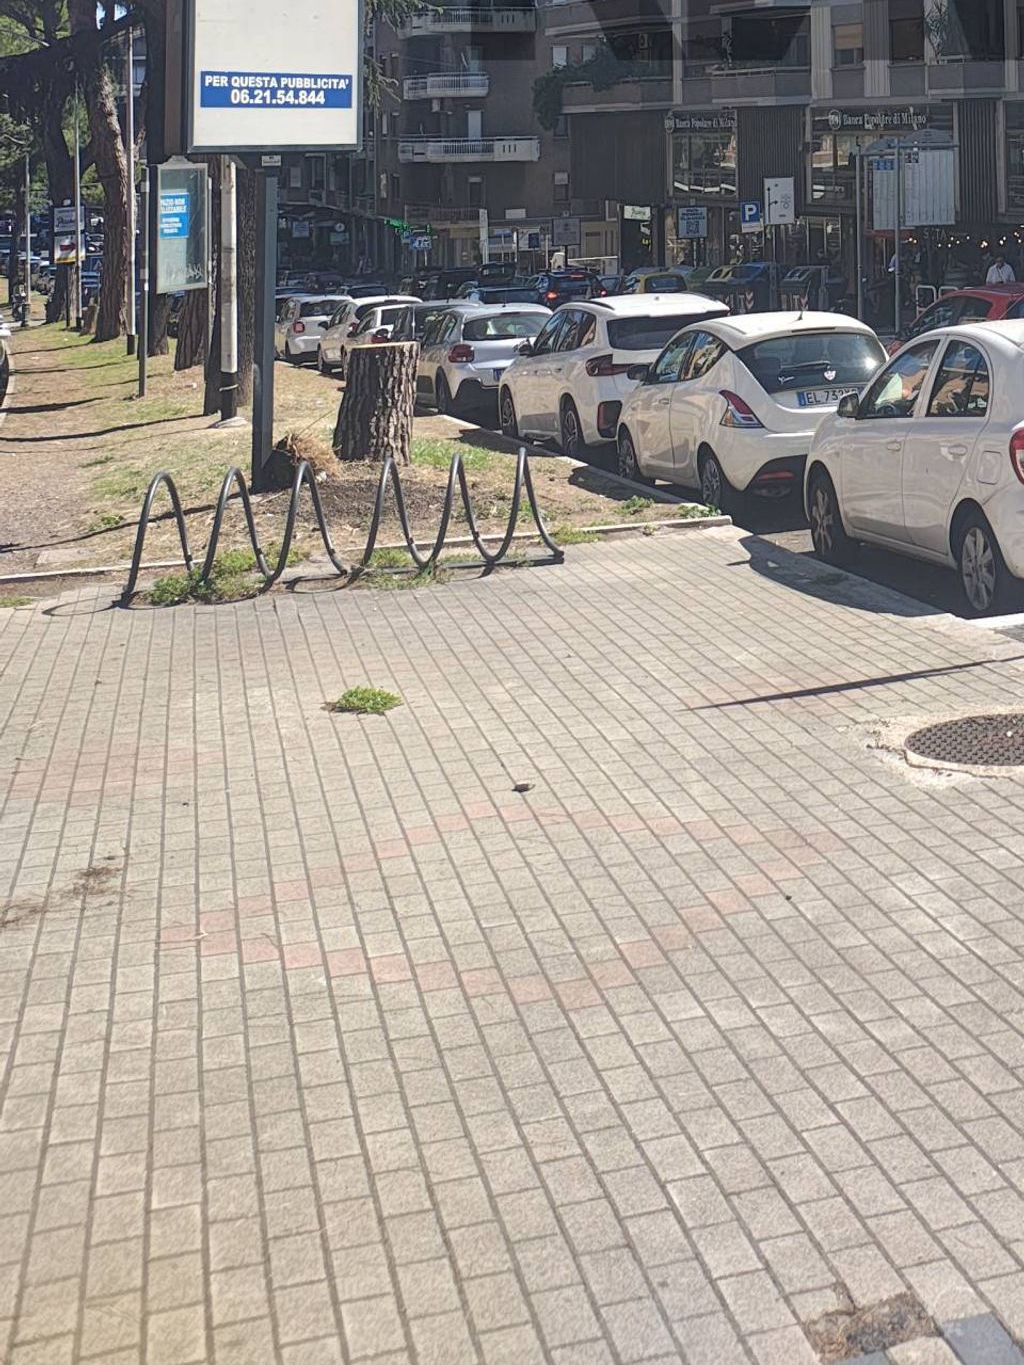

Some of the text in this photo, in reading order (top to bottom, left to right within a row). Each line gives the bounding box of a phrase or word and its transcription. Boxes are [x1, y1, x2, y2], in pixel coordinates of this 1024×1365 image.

[204, 75, 349, 89] PER QUESTA PUBBLICITA'
[230, 89, 326, 104] 06.21.54.844
[843, 114, 863, 125] Banca
[864, 114, 892, 127] Popolare
[893, 113, 900, 125] di
[901, 112, 926, 125] Milano
[744, 204, 757, 221] P
